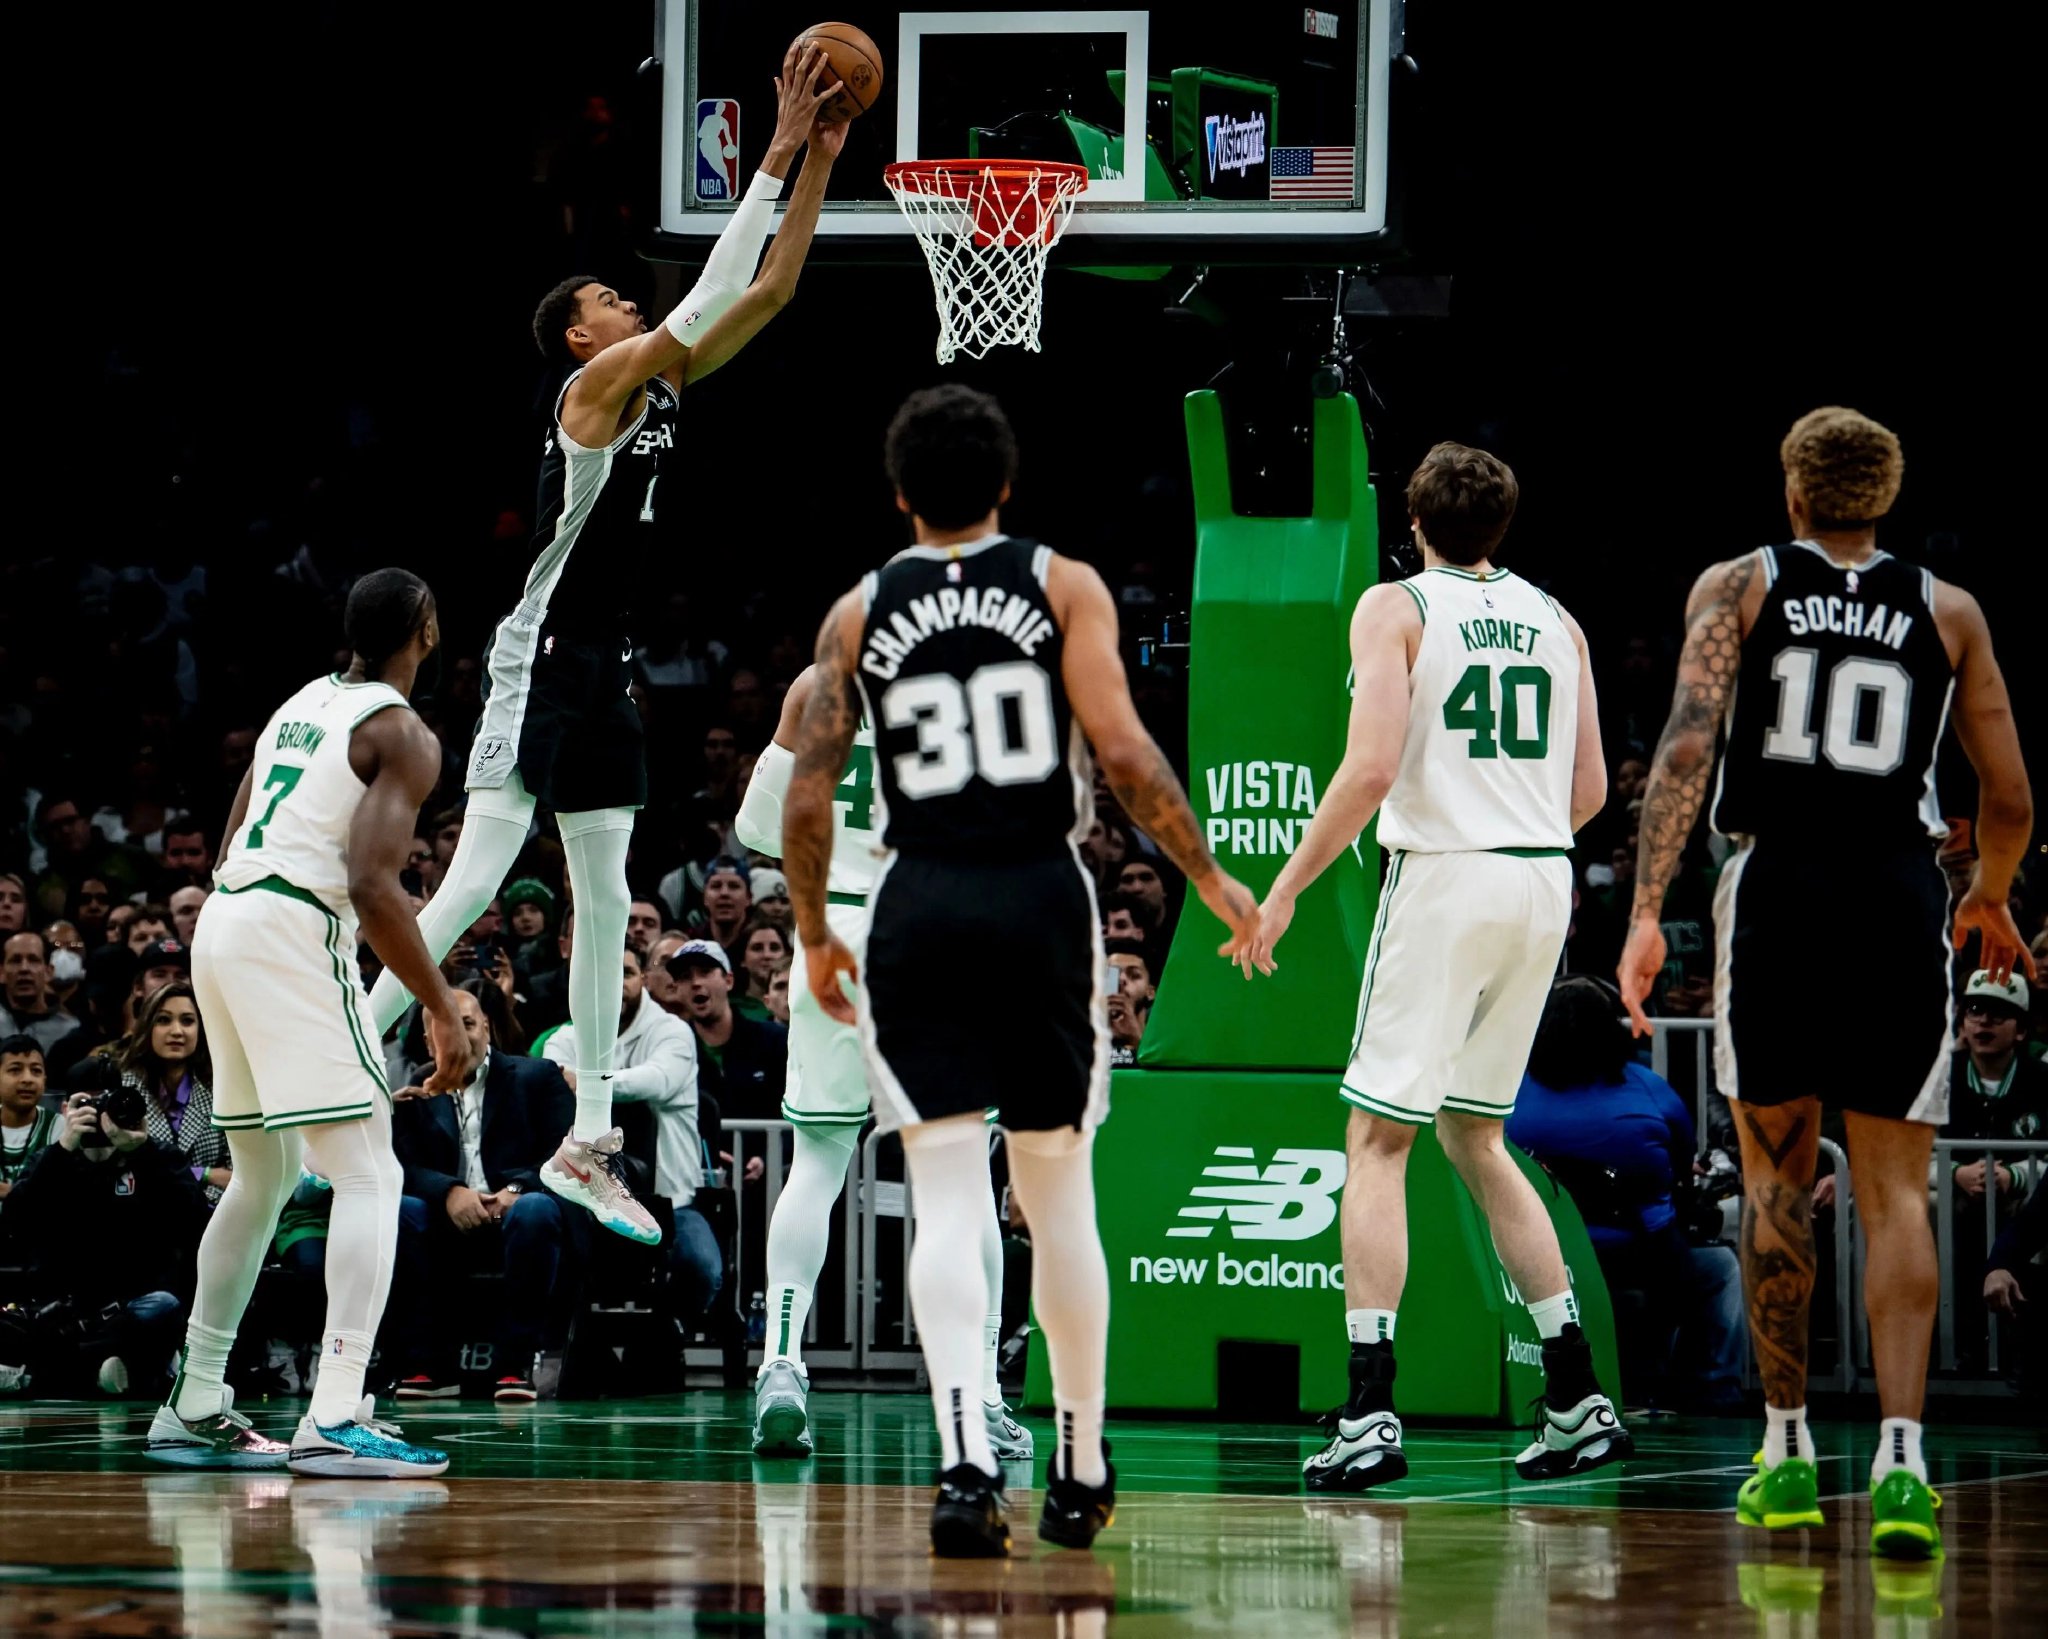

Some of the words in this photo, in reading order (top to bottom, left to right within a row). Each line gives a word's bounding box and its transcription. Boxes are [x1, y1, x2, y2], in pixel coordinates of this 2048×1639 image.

[701, 178, 722, 195] NBA
[639, 474, 660, 522] 1
[861, 585, 1054, 681] CHAMPAGNIE
[1458, 618, 1542, 656] KORNET
[1783, 594, 1913, 650] SOCHAN
[881, 659, 1060, 801] 30
[1442, 665, 1552, 760] 40
[1762, 645, 1914, 777] 10
[276, 721, 327, 758] BROWN
[245, 764, 305, 850] 7
[1206, 760, 1316, 816] VISTA
[1130, 1255, 1209, 1284] new
[1218, 1252, 1345, 1290] balanc
